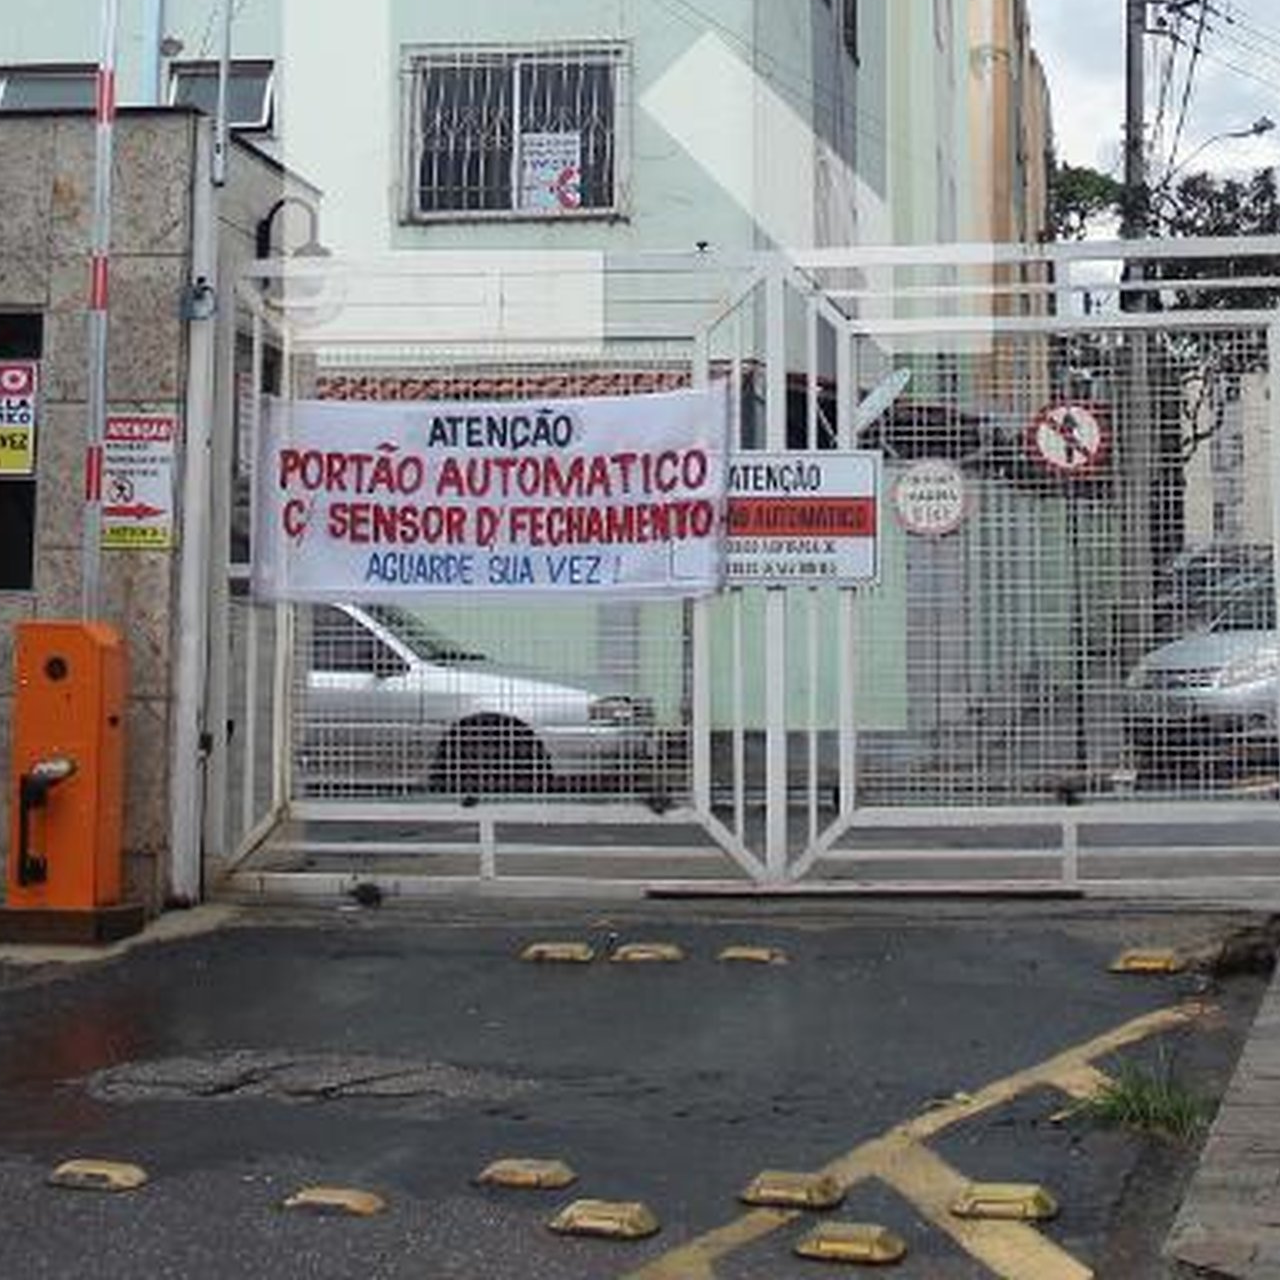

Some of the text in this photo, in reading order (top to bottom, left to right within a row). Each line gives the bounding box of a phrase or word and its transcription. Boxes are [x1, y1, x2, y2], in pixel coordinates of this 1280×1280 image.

[427, 408, 573, 451] ATENÇÃO
[279, 442, 708, 498] PORTÃO AUTOMATICO
[728, 460, 822, 493] ATENÇÃO
[328, 502, 468, 545] SENSOR
[509, 499, 714, 547] FECHAMENTO
[365, 551, 474, 585] AGUARDE
[488, 555, 535, 586] SUA
